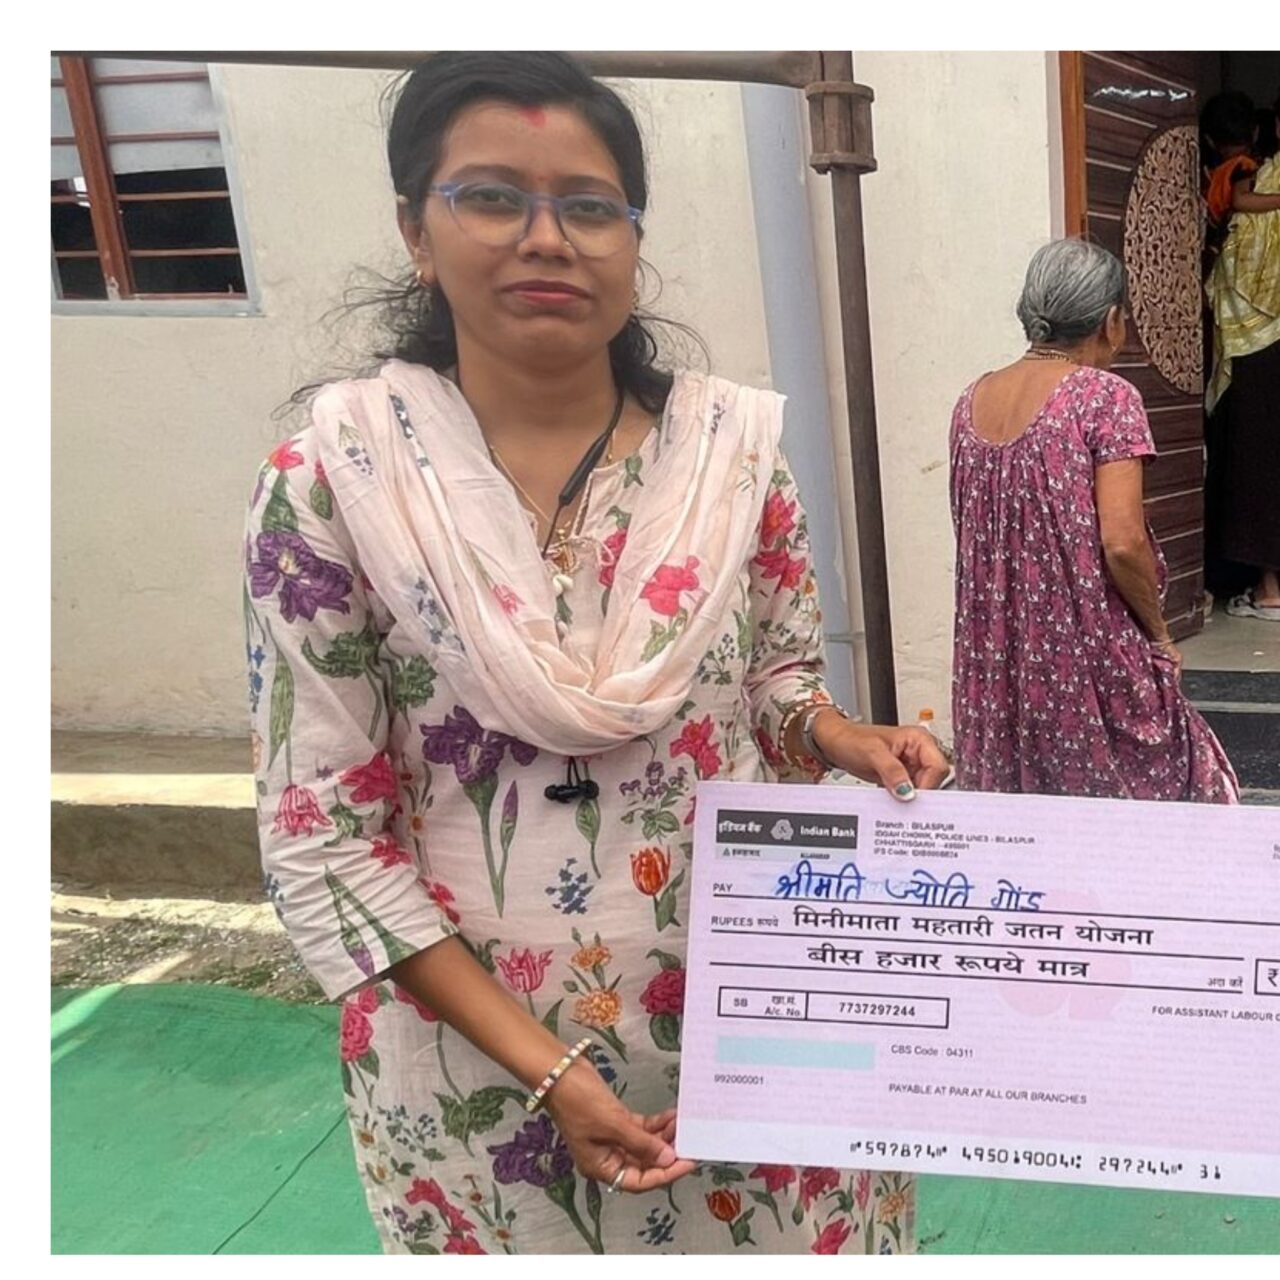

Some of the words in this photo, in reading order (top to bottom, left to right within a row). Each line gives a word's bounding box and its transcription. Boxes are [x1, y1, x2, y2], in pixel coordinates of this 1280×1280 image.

[800, 825, 829, 836] Indian
[831, 827, 856, 838] Bank
[875, 820, 904, 830] Branch
[911, 821, 955, 831] BILASPUR
[935, 833, 963, 842] POLICE
[995, 836, 1035, 844] BILASPUR
[713, 883, 733, 892] PAY
[711, 914, 754, 927] RUPEES
[793, 905, 900, 931] मिनीमाता
[912, 914, 993, 936] महतारी
[1005, 922, 1063, 940] जतन
[1075, 920, 1154, 946] योजना
[807, 943, 863, 965] बीस
[876, 951, 942, 970] हजार
[1037, 960, 1090, 977] मात्र
[1267, 968, 1279, 987] ₹
[839, 1002, 916, 1017] 7737297244
[1152, 1006, 1173, 1015] FOR
[1175, 1007, 1229, 1019] ASSISTANT
[1231, 1009, 1273, 1021] LABOUR
[891, 1044, 912, 1055] CBS
[914, 1046, 938, 1056] Code
[946, 1047, 973, 1058] 04311
[714, 1074, 764, 1085] 992000001
[889, 1083, 931, 1095] PAYABLE
[934, 1086, 946, 1095] AT
[950, 1087, 969, 1097] PAR
[971, 1089, 984, 1097] AT
[985, 1090, 1003, 1099] ALL
[1005, 1090, 1028, 1100] OUR
[1031, 1092, 1087, 1104] BRANCHES
[1200, 1164, 1221, 1179] 31
